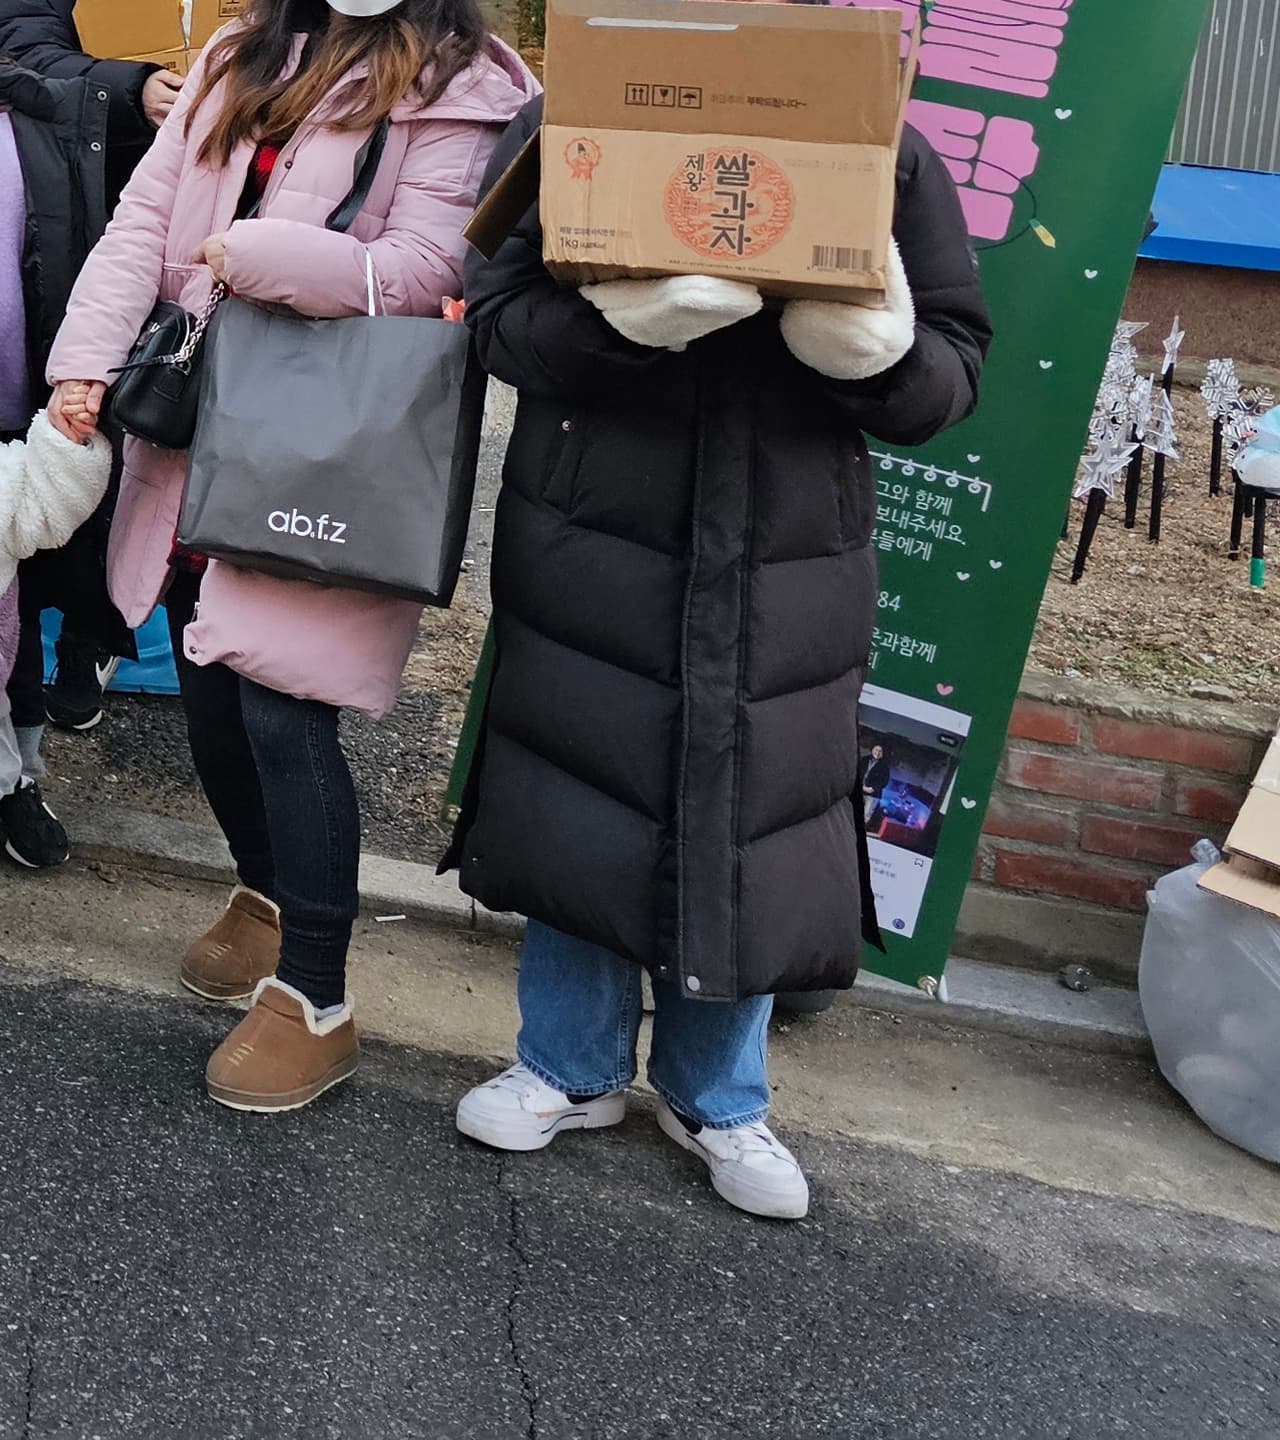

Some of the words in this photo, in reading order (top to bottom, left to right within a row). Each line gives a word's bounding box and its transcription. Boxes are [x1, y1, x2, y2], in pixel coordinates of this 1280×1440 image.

[683, 153, 707, 193] 제왕
[709, 152, 757, 256] 쌀과자
[915, 488, 954, 517] 함께
